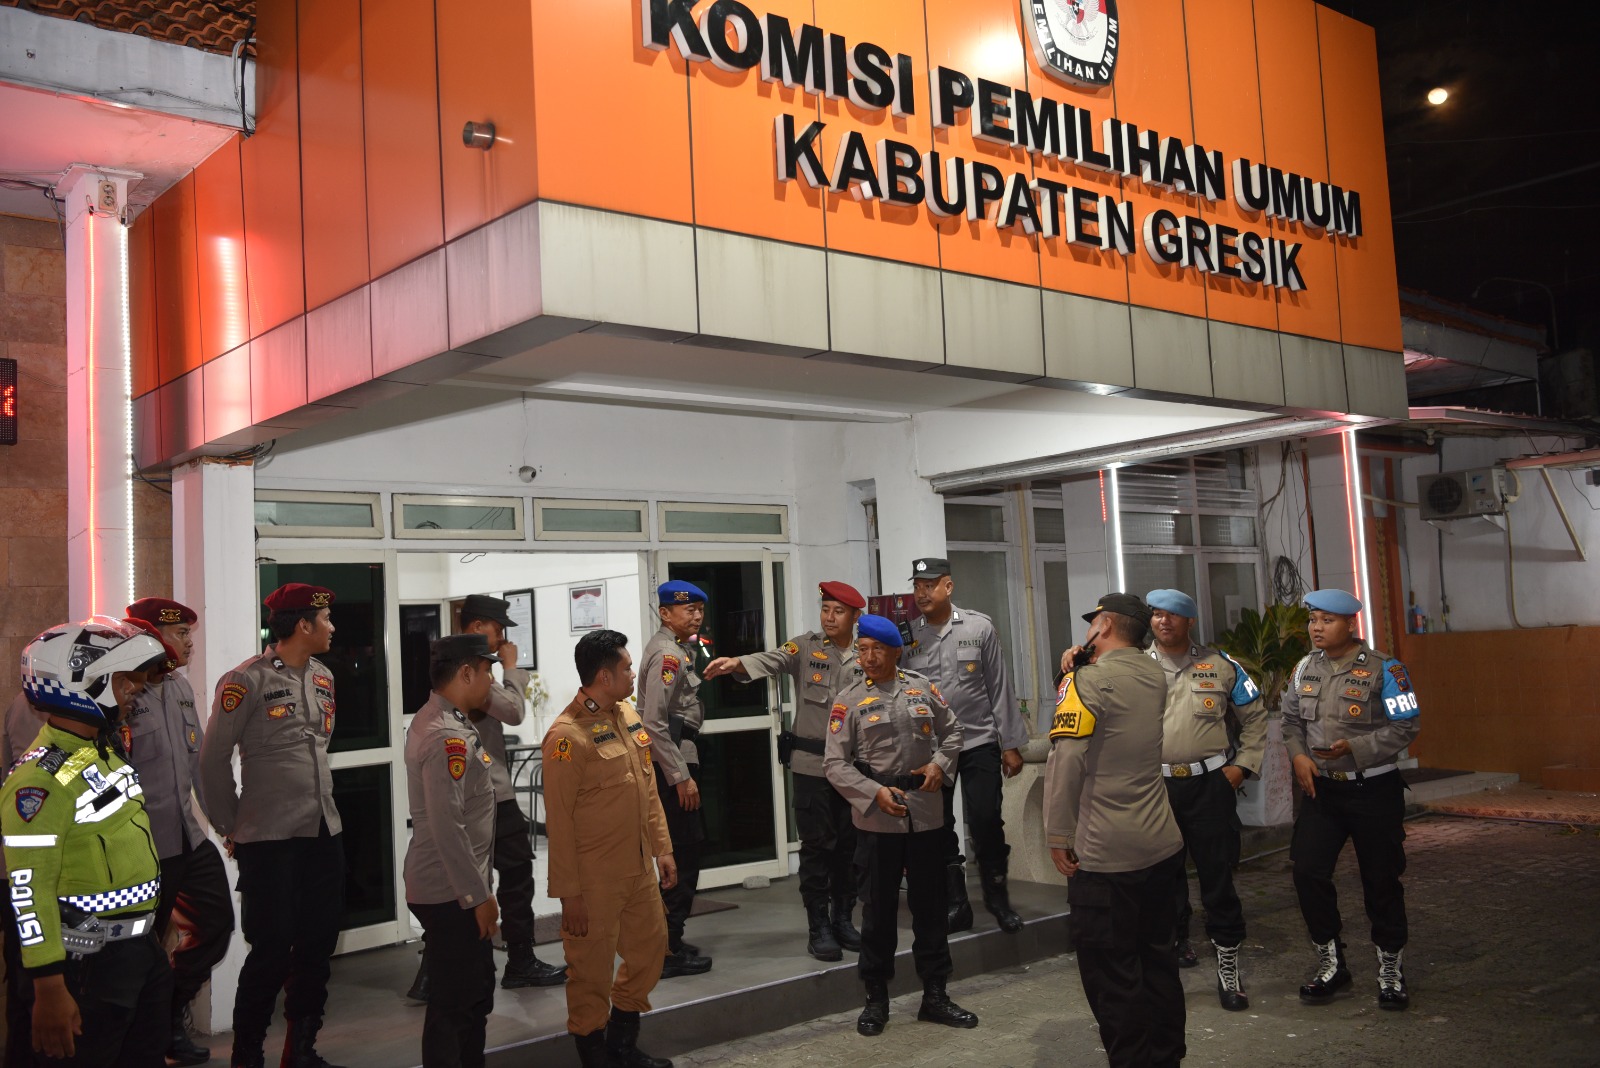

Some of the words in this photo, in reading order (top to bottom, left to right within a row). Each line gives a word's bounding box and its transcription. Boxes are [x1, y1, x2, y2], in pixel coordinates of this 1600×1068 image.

[1098, 17, 1118, 80] UMUM
[643, 0, 915, 118] KOMISI
[929, 65, 1223, 201] PEMILIHAN
[1233, 157, 1363, 238] UMUM
[775, 113, 1135, 255] KABUPATEN
[1144, 208, 1307, 292] GRESIK
[809, 660, 830, 671] HEPI
[1345, 678, 1370, 687] POLRI
[11, 868, 45, 947] POLISI
